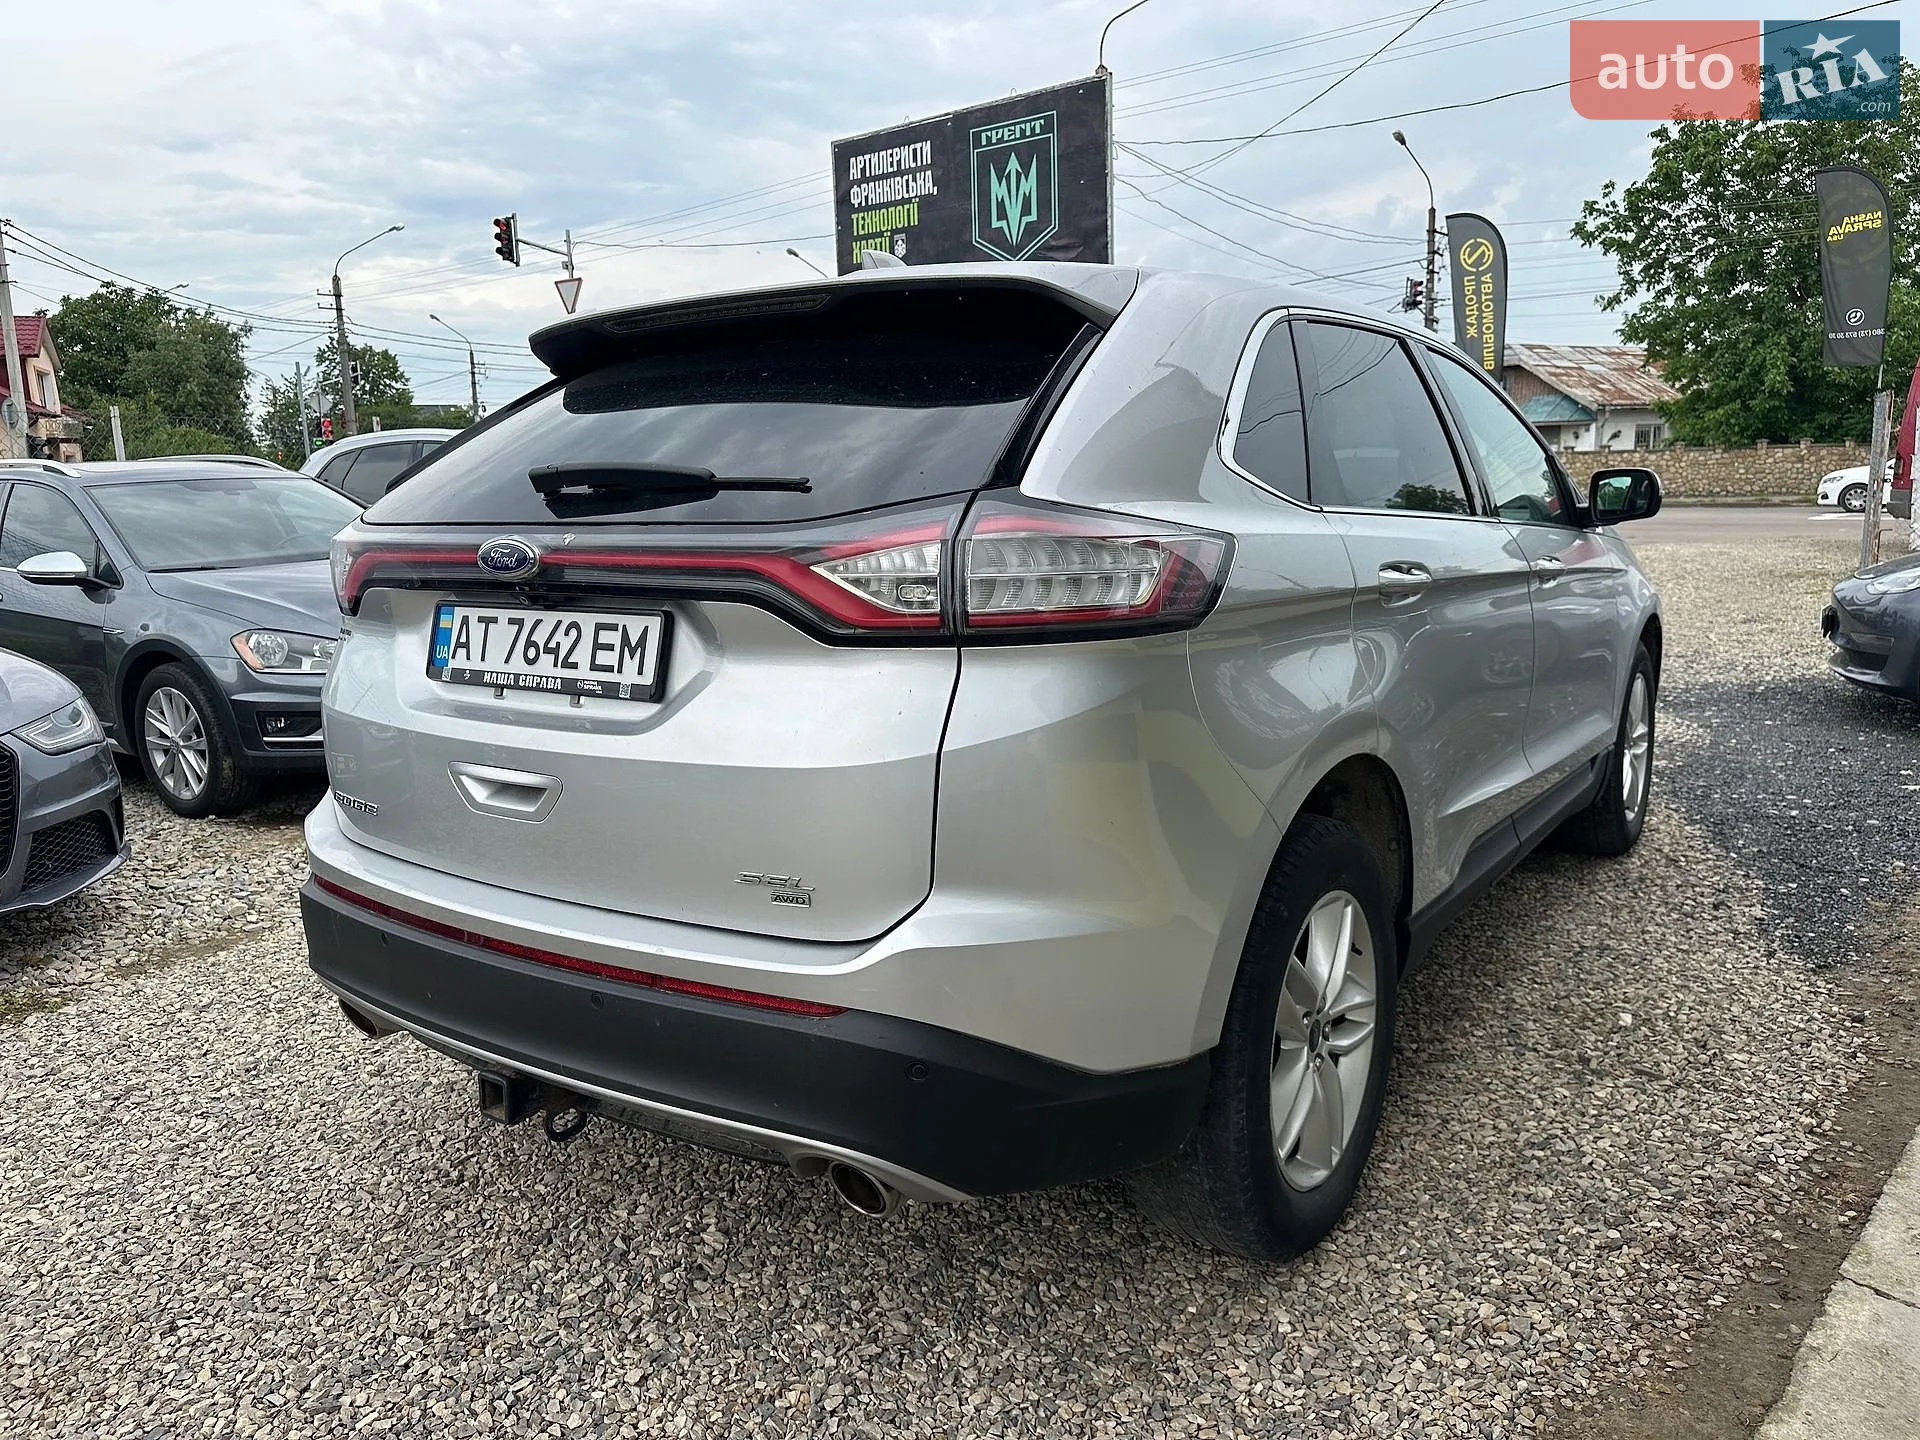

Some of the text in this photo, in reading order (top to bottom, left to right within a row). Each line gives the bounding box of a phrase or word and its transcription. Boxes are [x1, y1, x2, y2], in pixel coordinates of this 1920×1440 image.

[981, 119, 1045, 146] ГРЕГІТ
[849, 140, 932, 181] АРТИЛЕРИСТИ
[850, 170, 938, 208] ФРАНКІВСЬКА,
[851, 199, 919, 236] ТЕХНОЛОГІЇ
[488, 547, 518, 568] Ford
[436, 644, 449, 660] UA
[451, 615, 649, 675] AT 7642 EM
[483, 671, 562, 690] НАША СПРАВА
[334, 790, 379, 816] EDGE
[734, 871, 815, 892] SEL
[773, 894, 806, 905] AWD
